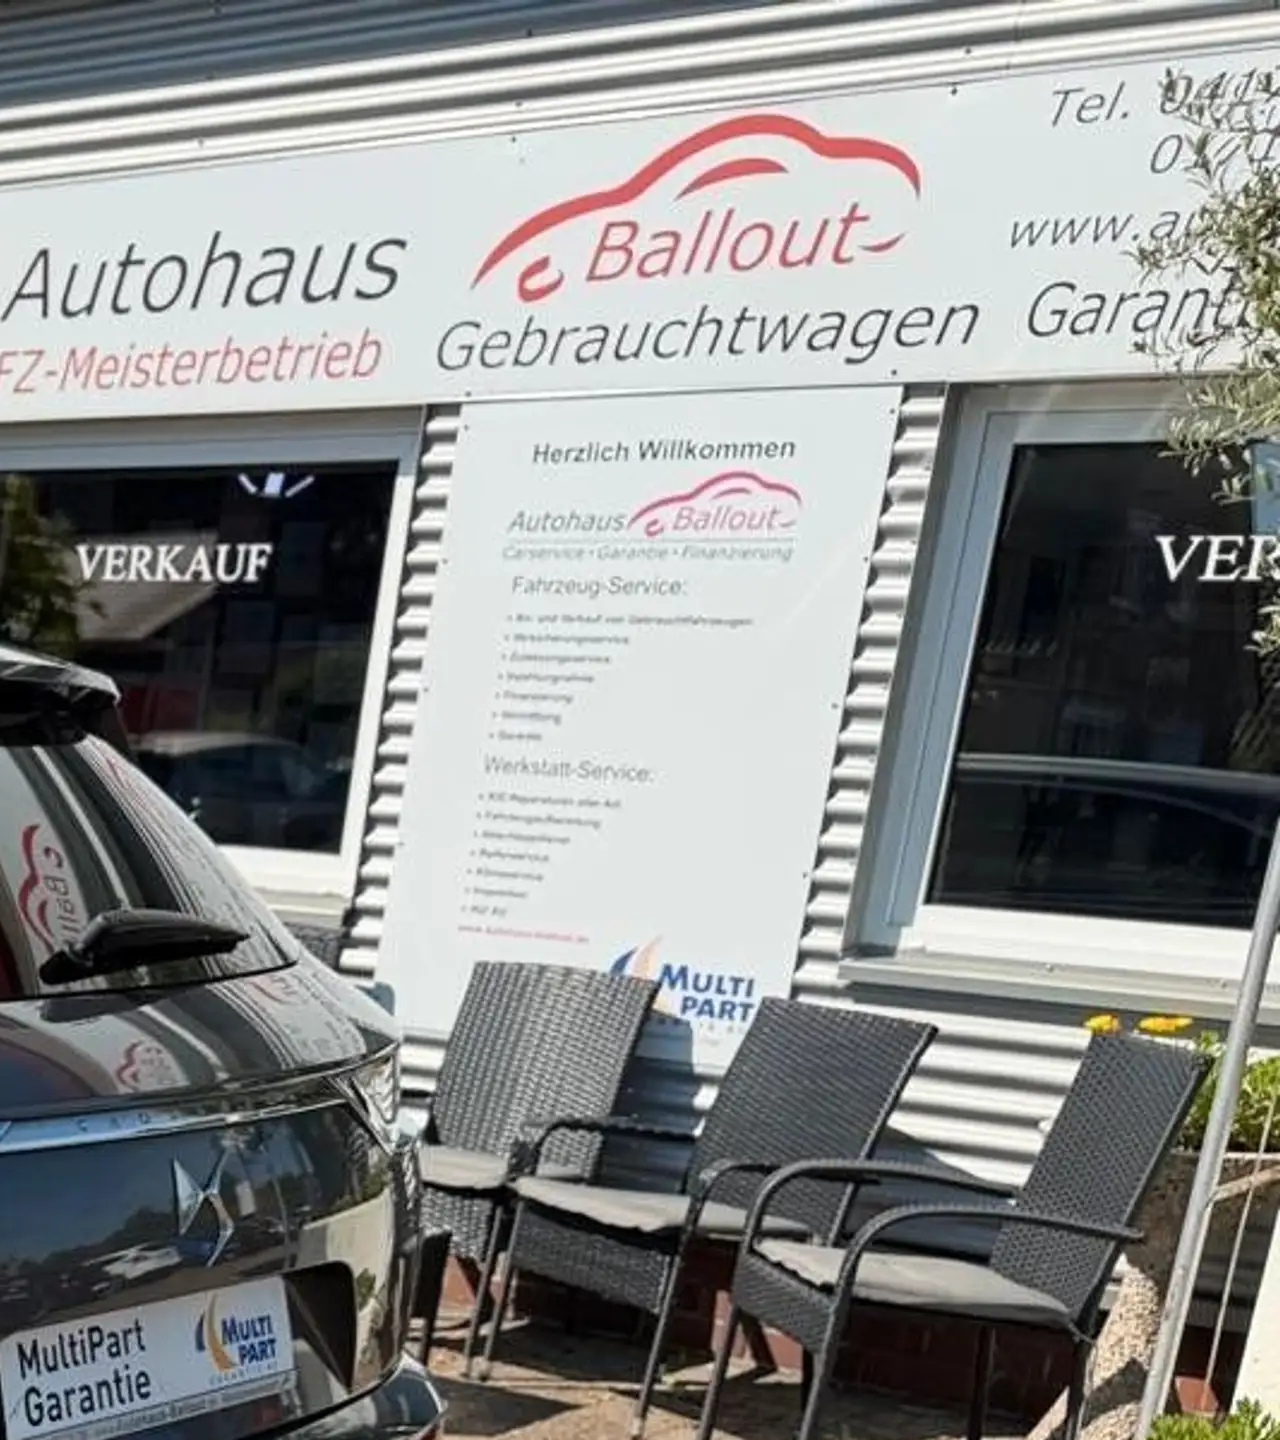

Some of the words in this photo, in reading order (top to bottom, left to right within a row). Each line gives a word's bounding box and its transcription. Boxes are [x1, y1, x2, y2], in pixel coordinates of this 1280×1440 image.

[1051, 80, 1130, 128] Tel.
[0, 231, 408, 323] Autohaus
[584, 202, 871, 284] Ballout
[438, 303, 979, 371] Gebrauchtwagen
[532, 442, 629, 464] Herzlich
[638, 440, 797, 460] Willkommen
[506, 510, 628, 533] Autohaus
[672, 505, 780, 532] Ballout
[76, 543, 273, 582] VERKAUF
[511, 575, 689, 600] Fahrzeug-Service:
[484, 752, 656, 784] Werkstatt-Service:
[660, 963, 756, 998] MULTI
[680, 996, 756, 1023] PART
[221, 1315, 273, 1345] MULTI
[17, 1319, 146, 1380] MultiPart
[239, 1339, 277, 1366] PART
[23, 1364, 153, 1428] Garantie
